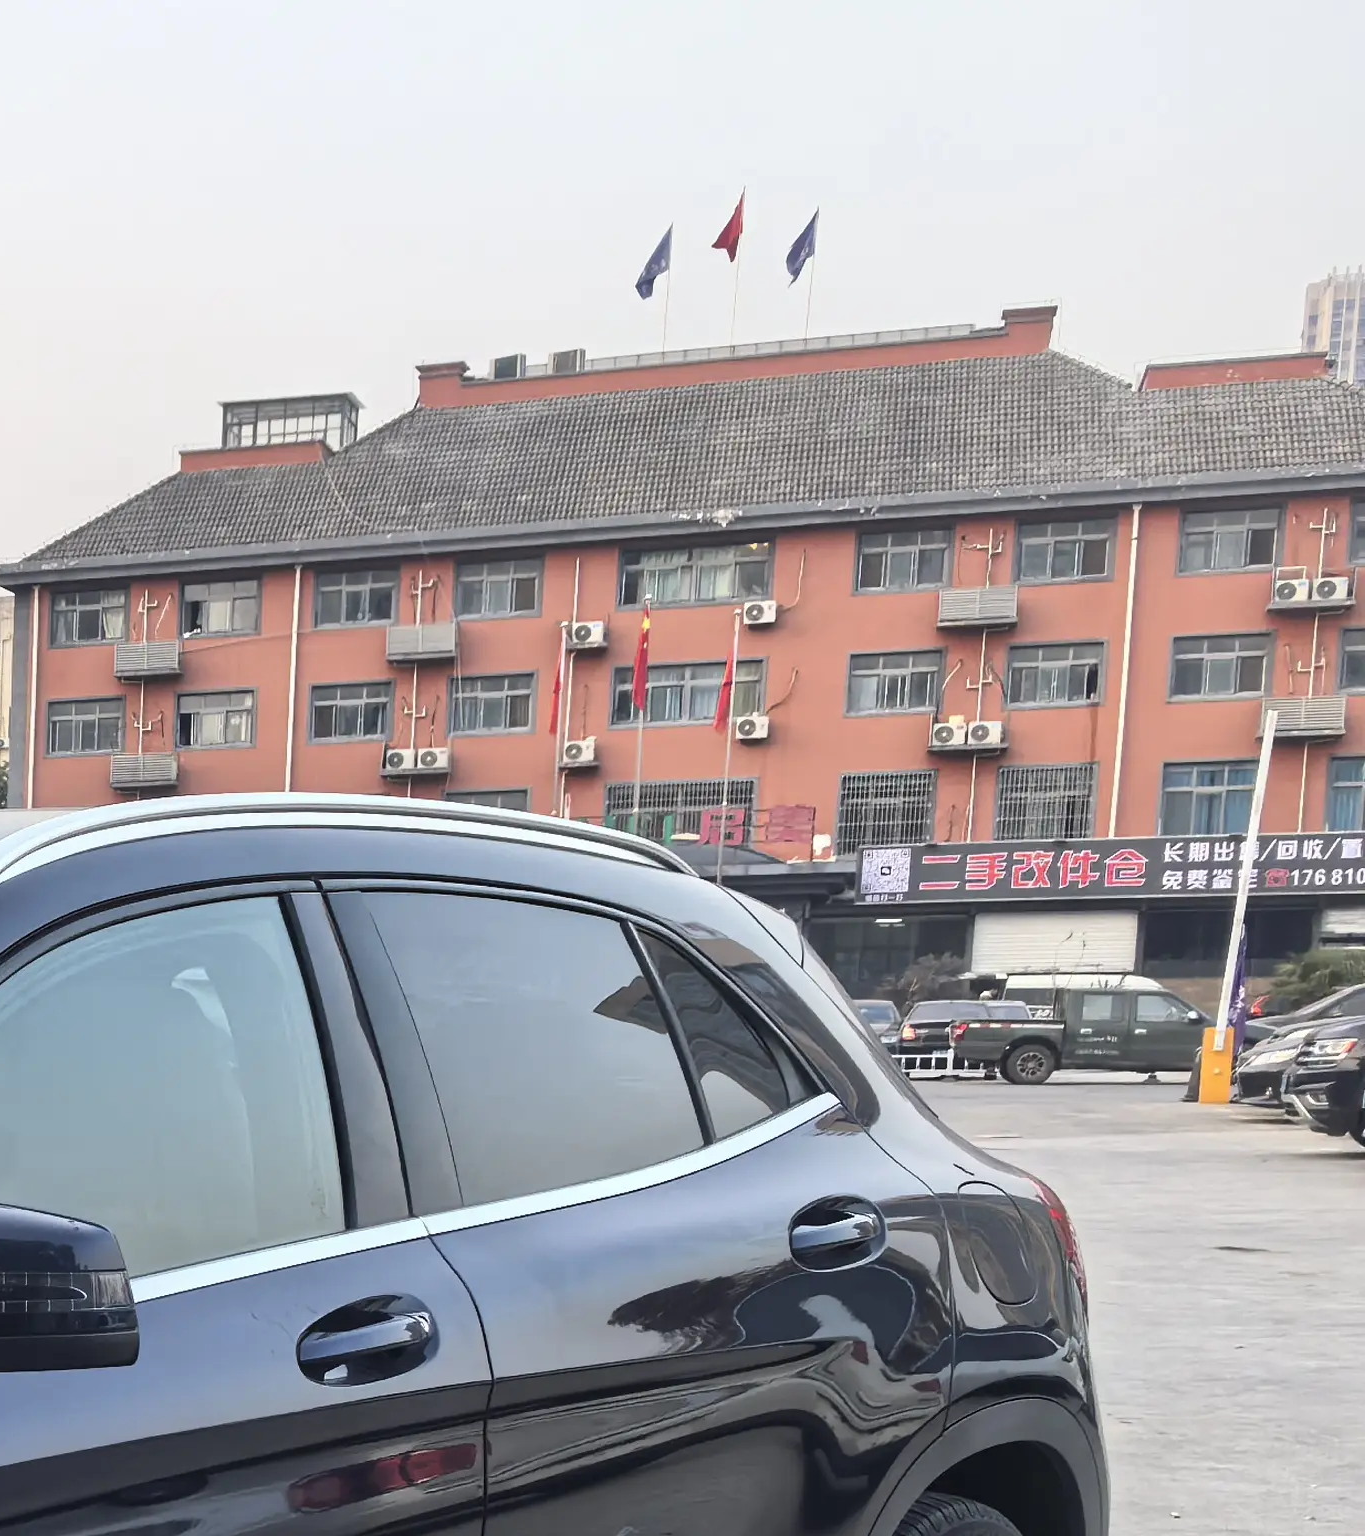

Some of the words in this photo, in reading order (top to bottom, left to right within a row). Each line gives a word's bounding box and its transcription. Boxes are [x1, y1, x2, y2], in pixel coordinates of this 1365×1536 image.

[919, 848, 1149, 891] 二手改件仓
